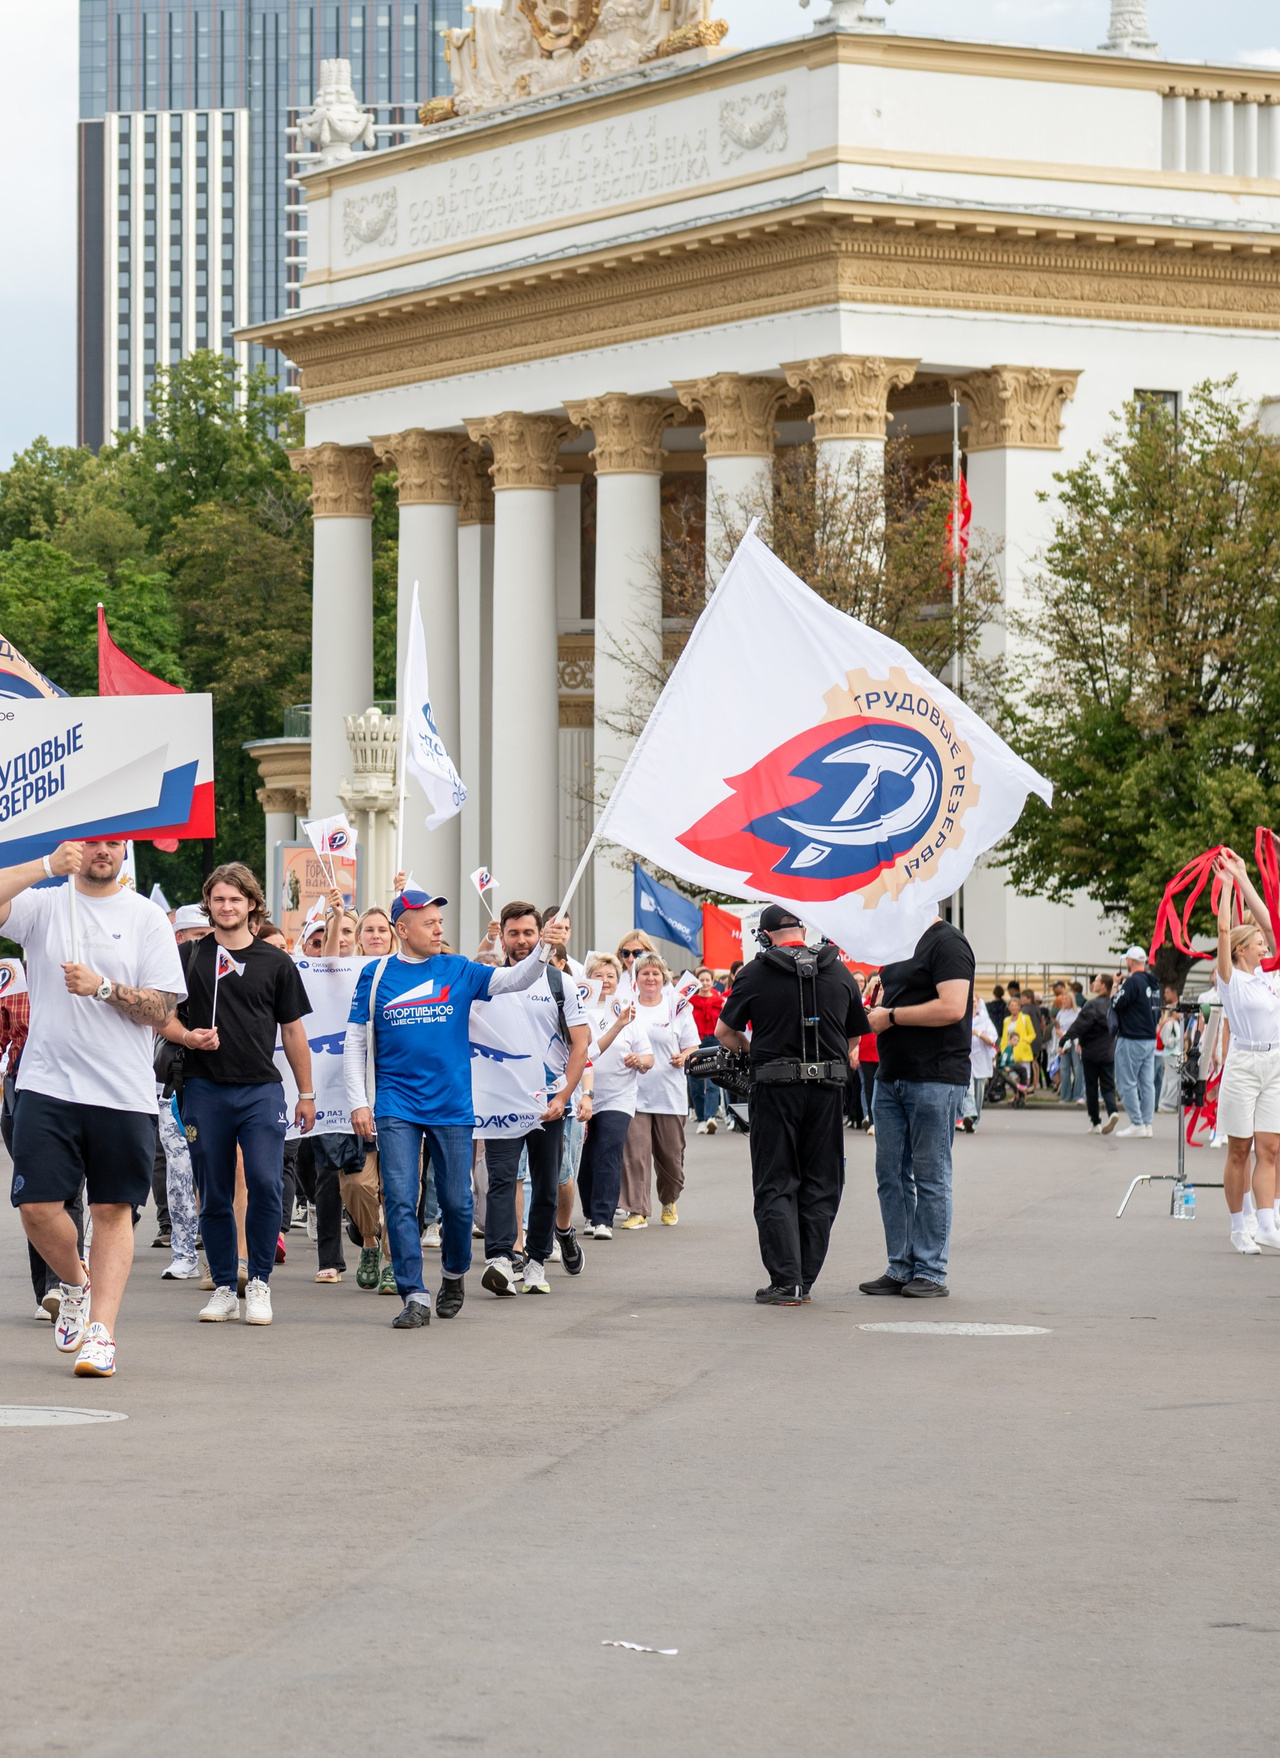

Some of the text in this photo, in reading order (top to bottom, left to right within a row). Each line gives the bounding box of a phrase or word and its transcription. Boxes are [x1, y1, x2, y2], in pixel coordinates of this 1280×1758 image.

[408, 127, 708, 222] СОВЕТСКАЯ ФЕДЕРАТИВНАЯ
[448, 114, 658, 188] РОССИЙСКАЯ
[408, 155, 711, 247] СОЦИАЛИСТИЧЕСКАЯ РЕСПУБЛИКА
[904, 765, 966, 879] РЕЗЕРВЫ
[382, 1005, 454, 1020] СПОРТИВНОЕ
[390, 1016, 447, 1026] ШЕСТВИЕ
[531, 994, 552, 1003] ОАК
